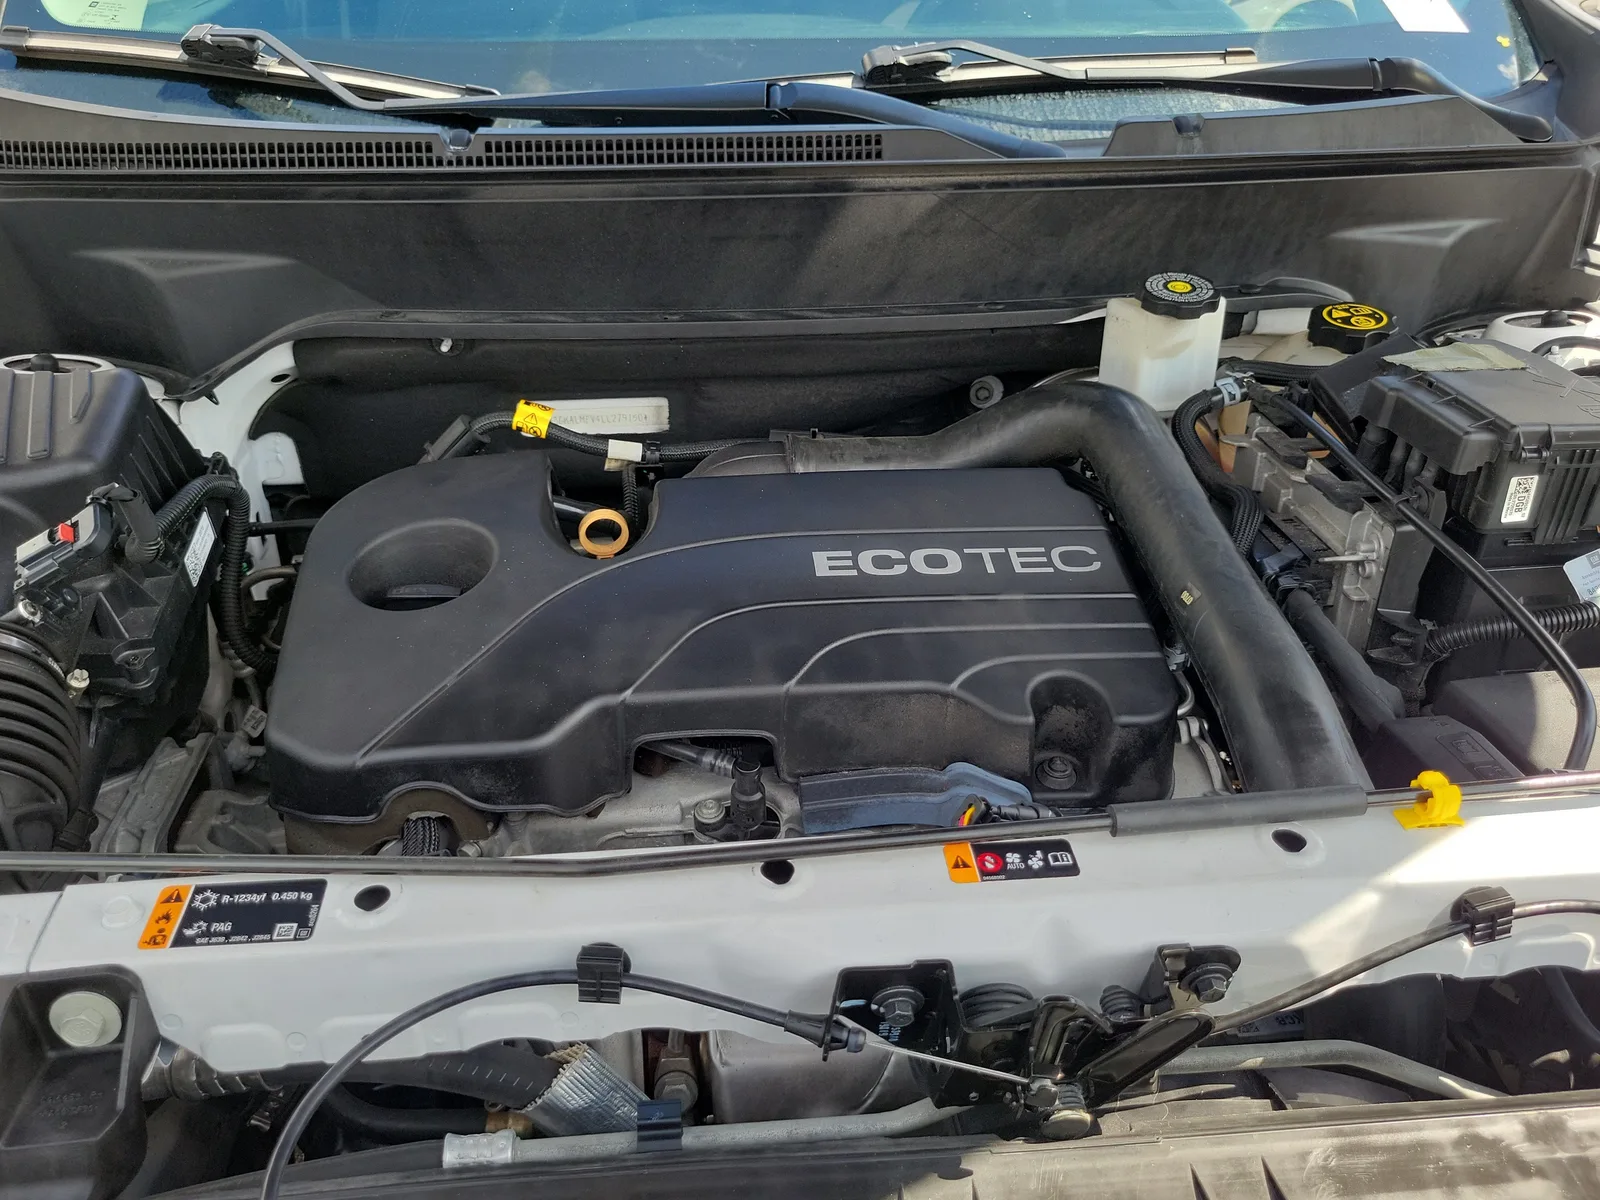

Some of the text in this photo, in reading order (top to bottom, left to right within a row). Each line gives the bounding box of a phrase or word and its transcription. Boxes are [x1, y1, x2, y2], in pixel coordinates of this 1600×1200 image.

[1514, 495, 1526, 513] DGB
[812, 545, 1101, 577] ECOTEC
[221, 891, 313, 904] R-1234yf 0.450 kg
[211, 922, 232, 932] PAG
